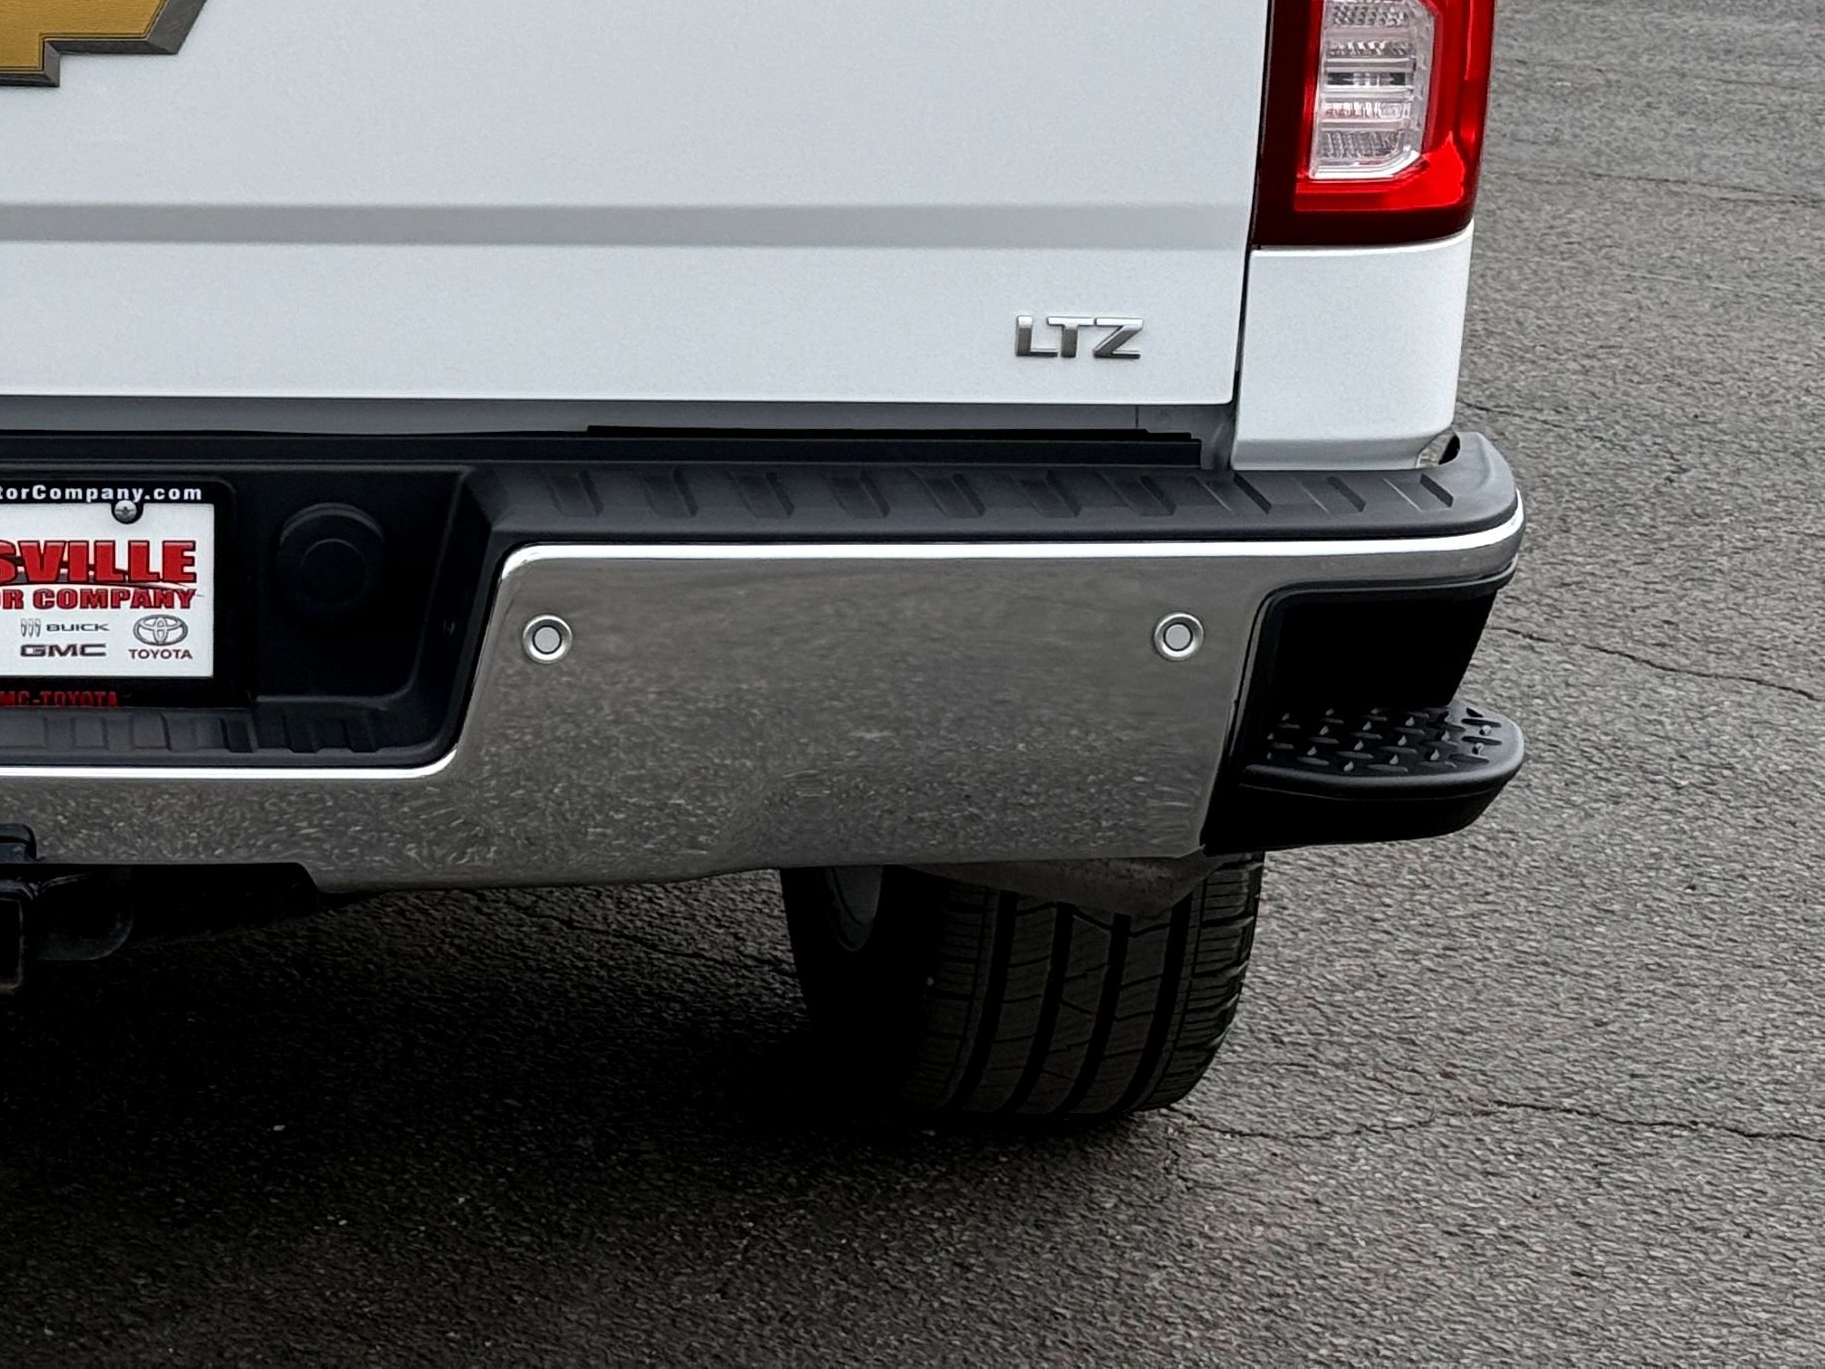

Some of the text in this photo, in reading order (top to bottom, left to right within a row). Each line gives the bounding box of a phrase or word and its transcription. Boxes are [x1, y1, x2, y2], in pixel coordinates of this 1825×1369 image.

[1015, 315, 1144, 358] LTZ
[33, 588, 197, 611] COMPANY
[45, 623, 111, 633] BUICK
[20, 643, 108, 658] GMC
[128, 648, 194, 660] TOYOTA
